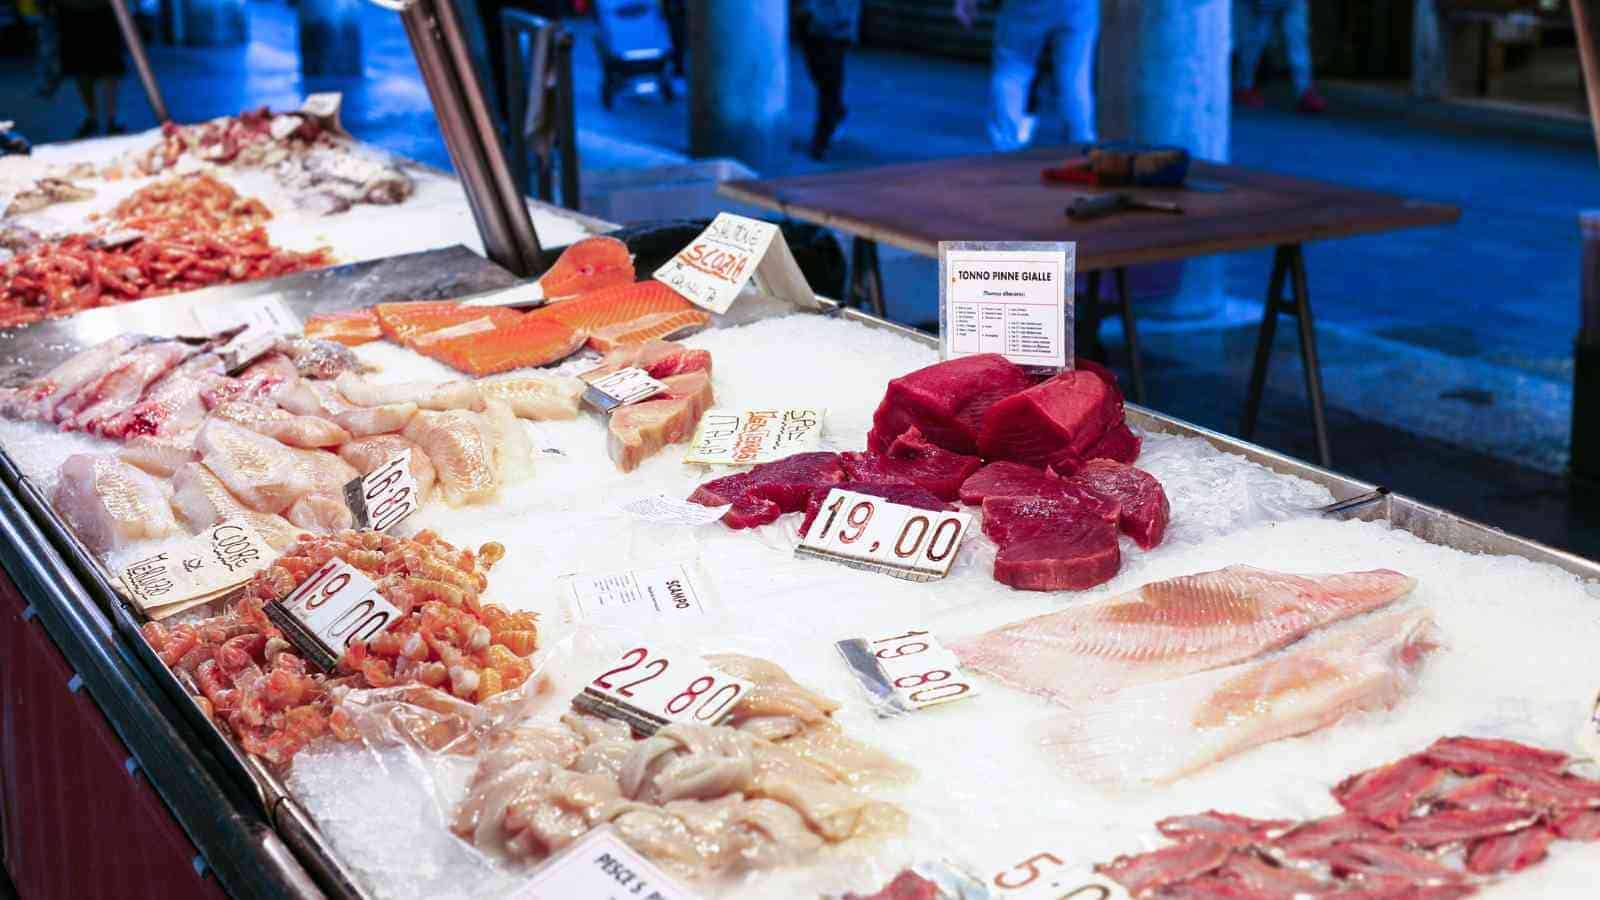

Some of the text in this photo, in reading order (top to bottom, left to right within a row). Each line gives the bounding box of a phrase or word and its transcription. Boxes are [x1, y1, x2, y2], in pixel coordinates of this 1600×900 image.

[958, 271, 1053, 281] TONNO PINNE GIALLE
[818, 496, 962, 562] 19,00
[665, 580, 690, 609] SCAMPO
